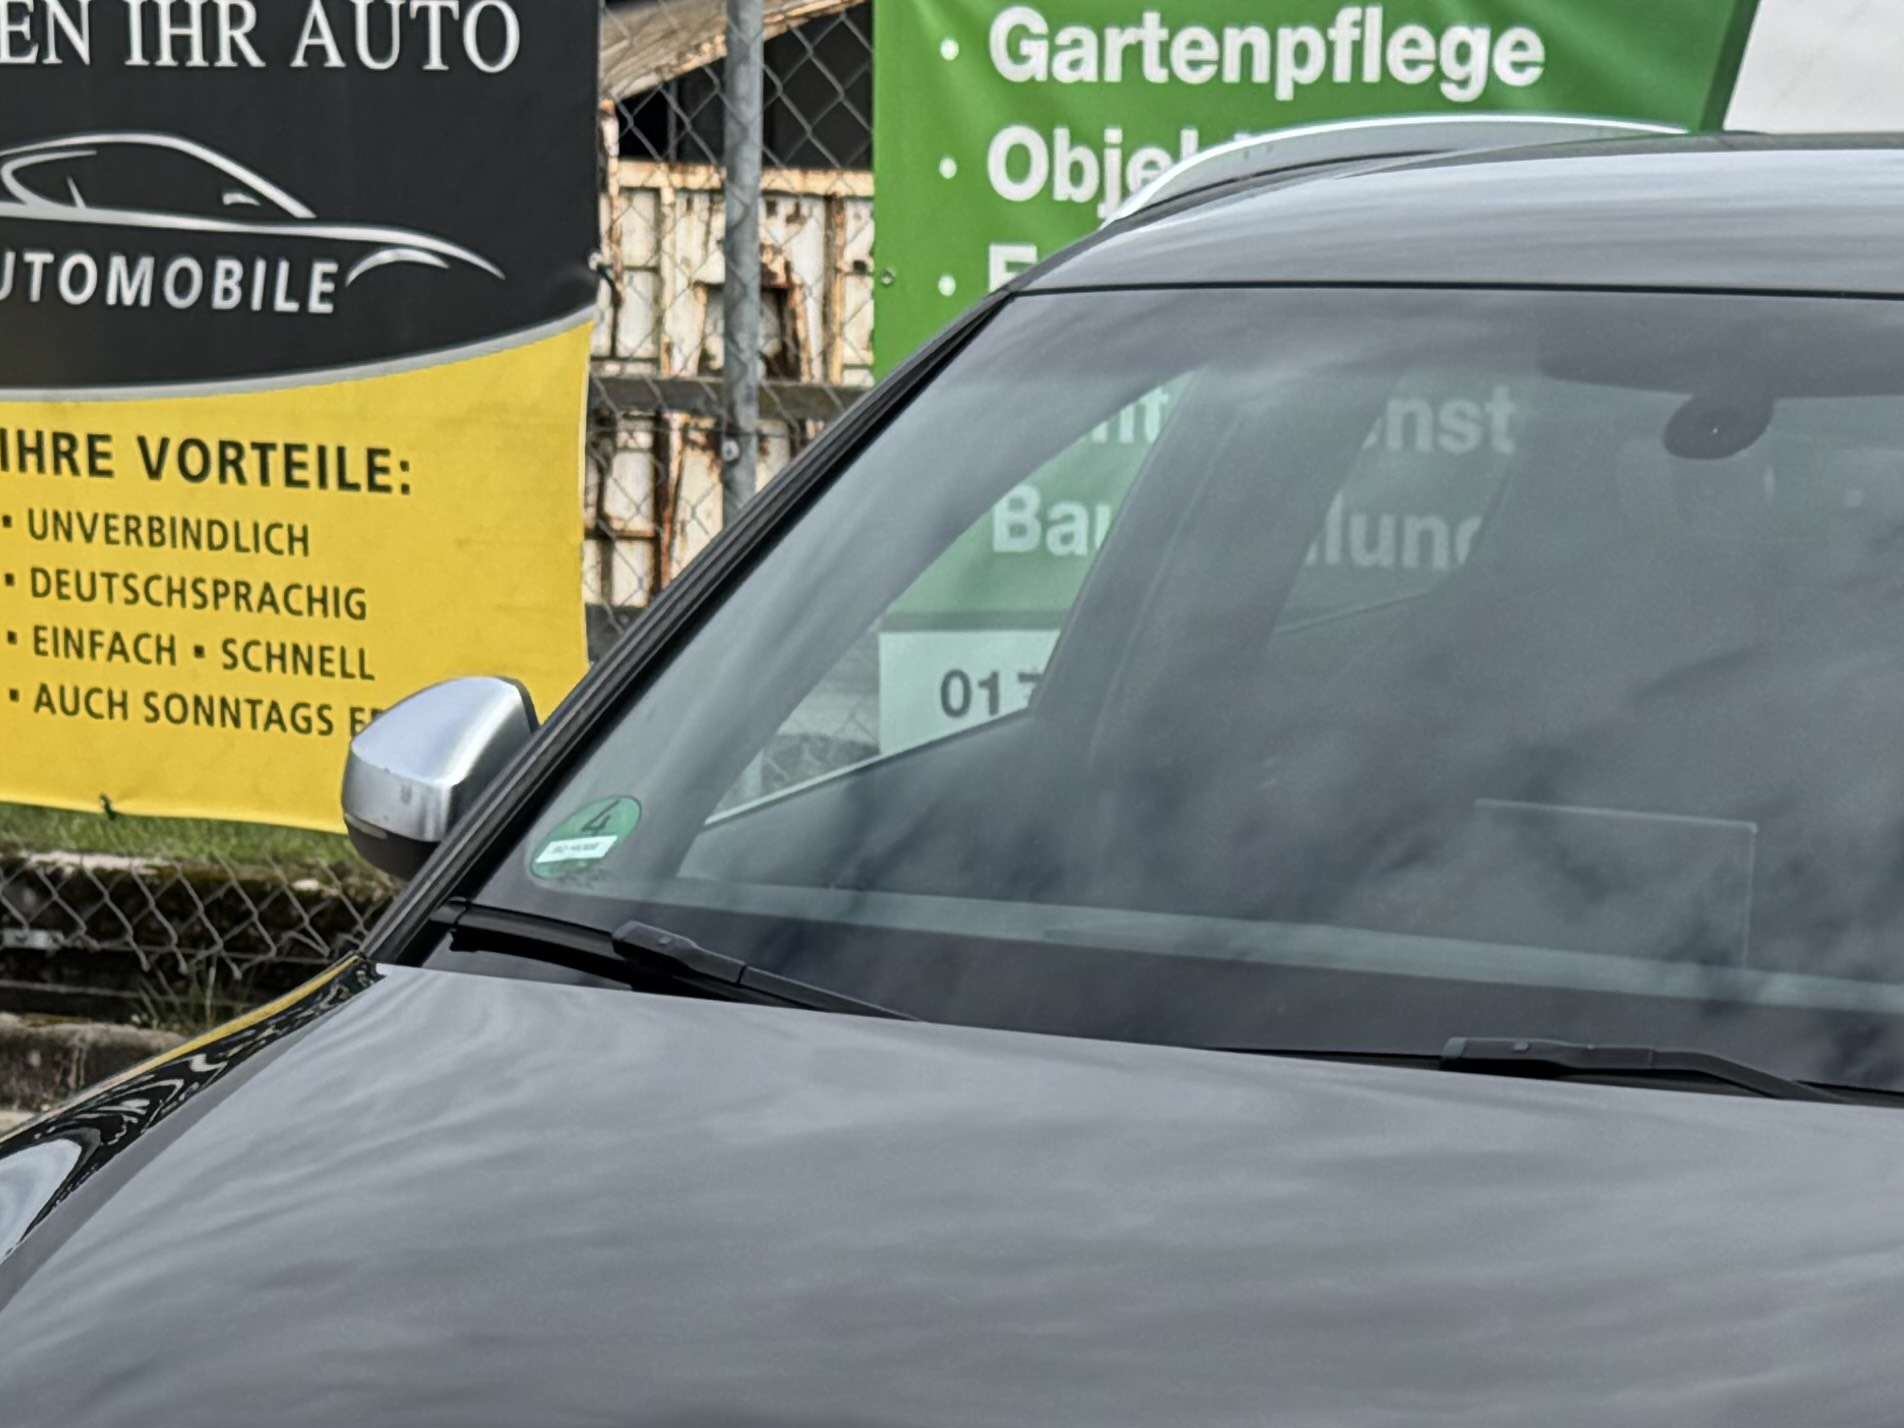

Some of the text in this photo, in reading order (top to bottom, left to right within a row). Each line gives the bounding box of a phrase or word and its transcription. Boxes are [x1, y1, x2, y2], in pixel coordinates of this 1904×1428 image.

[124, 0, 265, 69] IHR
[290, 0, 521, 73] AUTO
[987, 5, 1546, 103] Gartenpflege
[136, 434, 412, 496] VORTEILE:
[27, 507, 311, 558] UNVERBINDLICH
[29, 566, 368, 622] DEUTSCHSPRACHIG
[33, 625, 375, 682] EINFACH SCHNELL
[34, 681, 129, 722] AUCH
[143, 691, 335, 738] SONNTAGS
